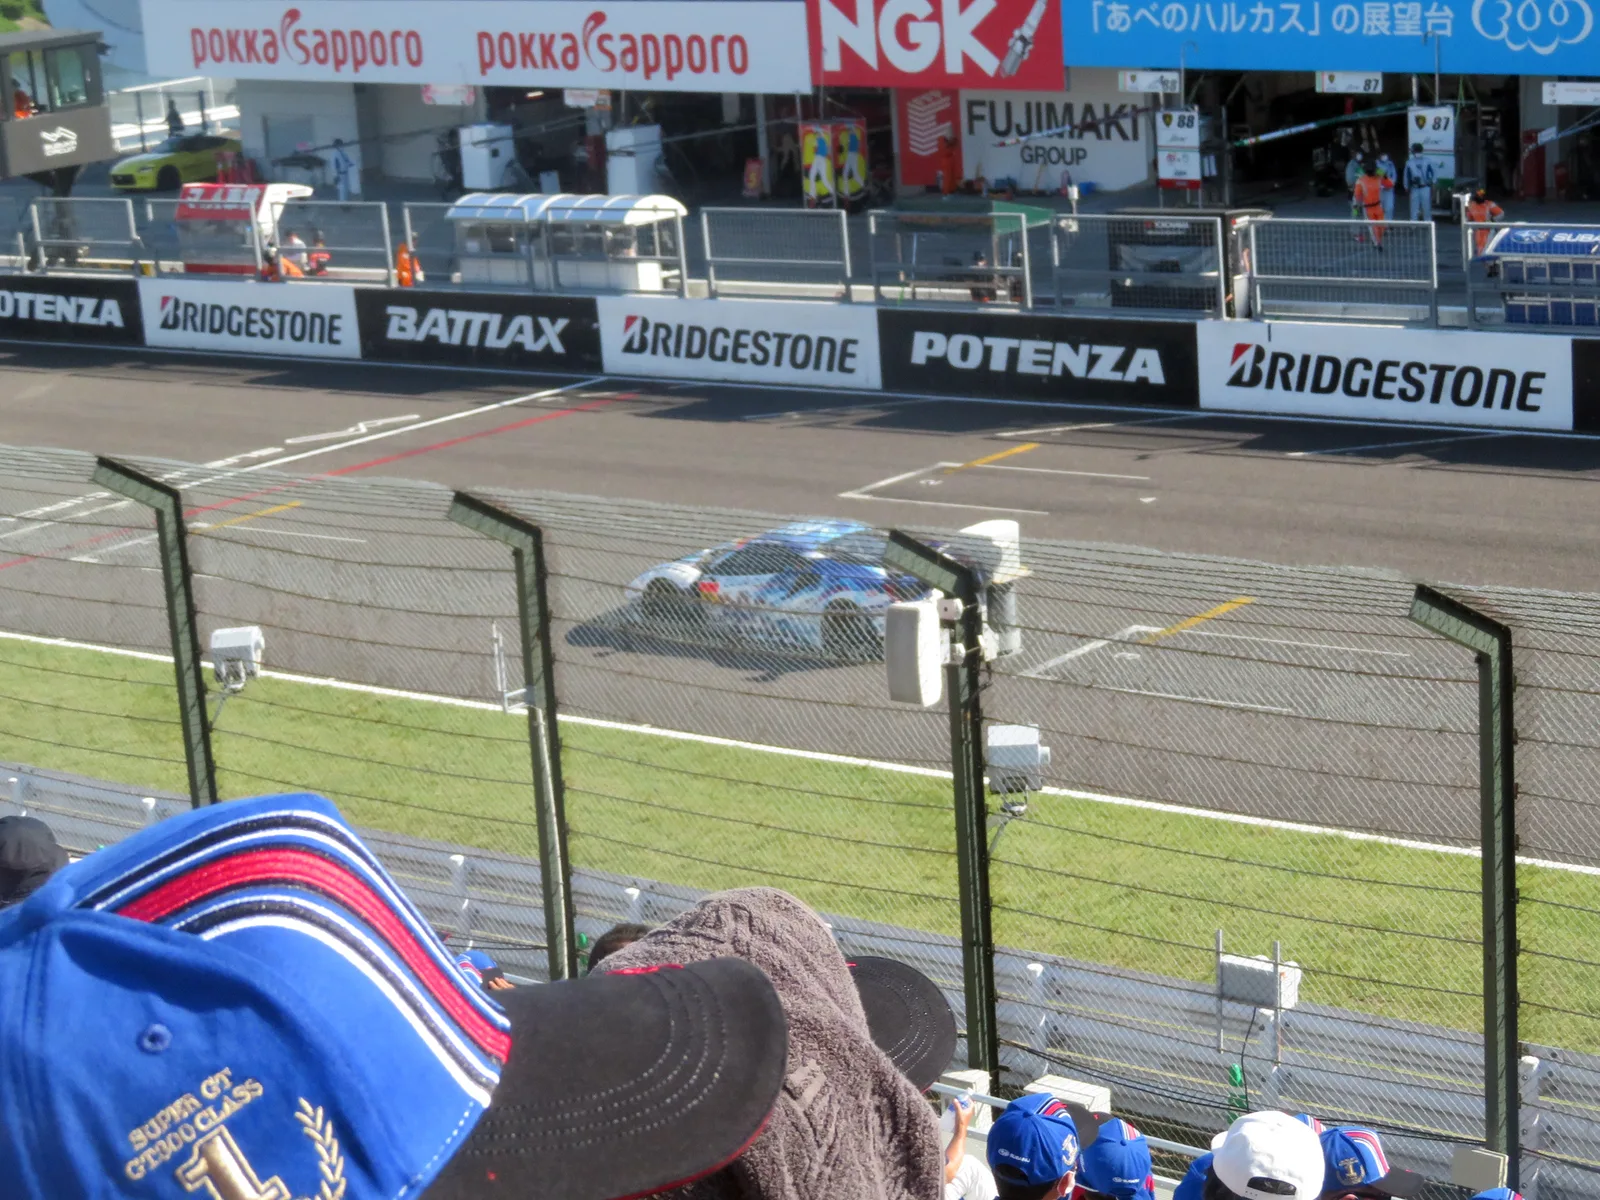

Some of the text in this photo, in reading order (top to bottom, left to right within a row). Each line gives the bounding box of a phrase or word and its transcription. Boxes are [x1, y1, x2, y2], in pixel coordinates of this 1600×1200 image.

[818, 0, 1002, 77] NGK
[1363, 78, 1380, 92] 87
[965, 99, 1140, 142] FUJIMAKI
[1177, 113, 1195, 129] 88
[1432, 116, 1450, 131] 87
[1020, 144, 1088, 166] GROUP
[160, 296, 343, 345] BRIDGESTONE
[385, 305, 570, 354] BATTLAX
[621, 315, 860, 375] BRIDGESTONE
[910, 330, 1166, 385] POTENZA
[1226, 343, 1546, 412] BRIDGESTONE
[124, 1077, 264, 1181] GT300 CLASS
[128, 1066, 233, 1151] SUPER GT
